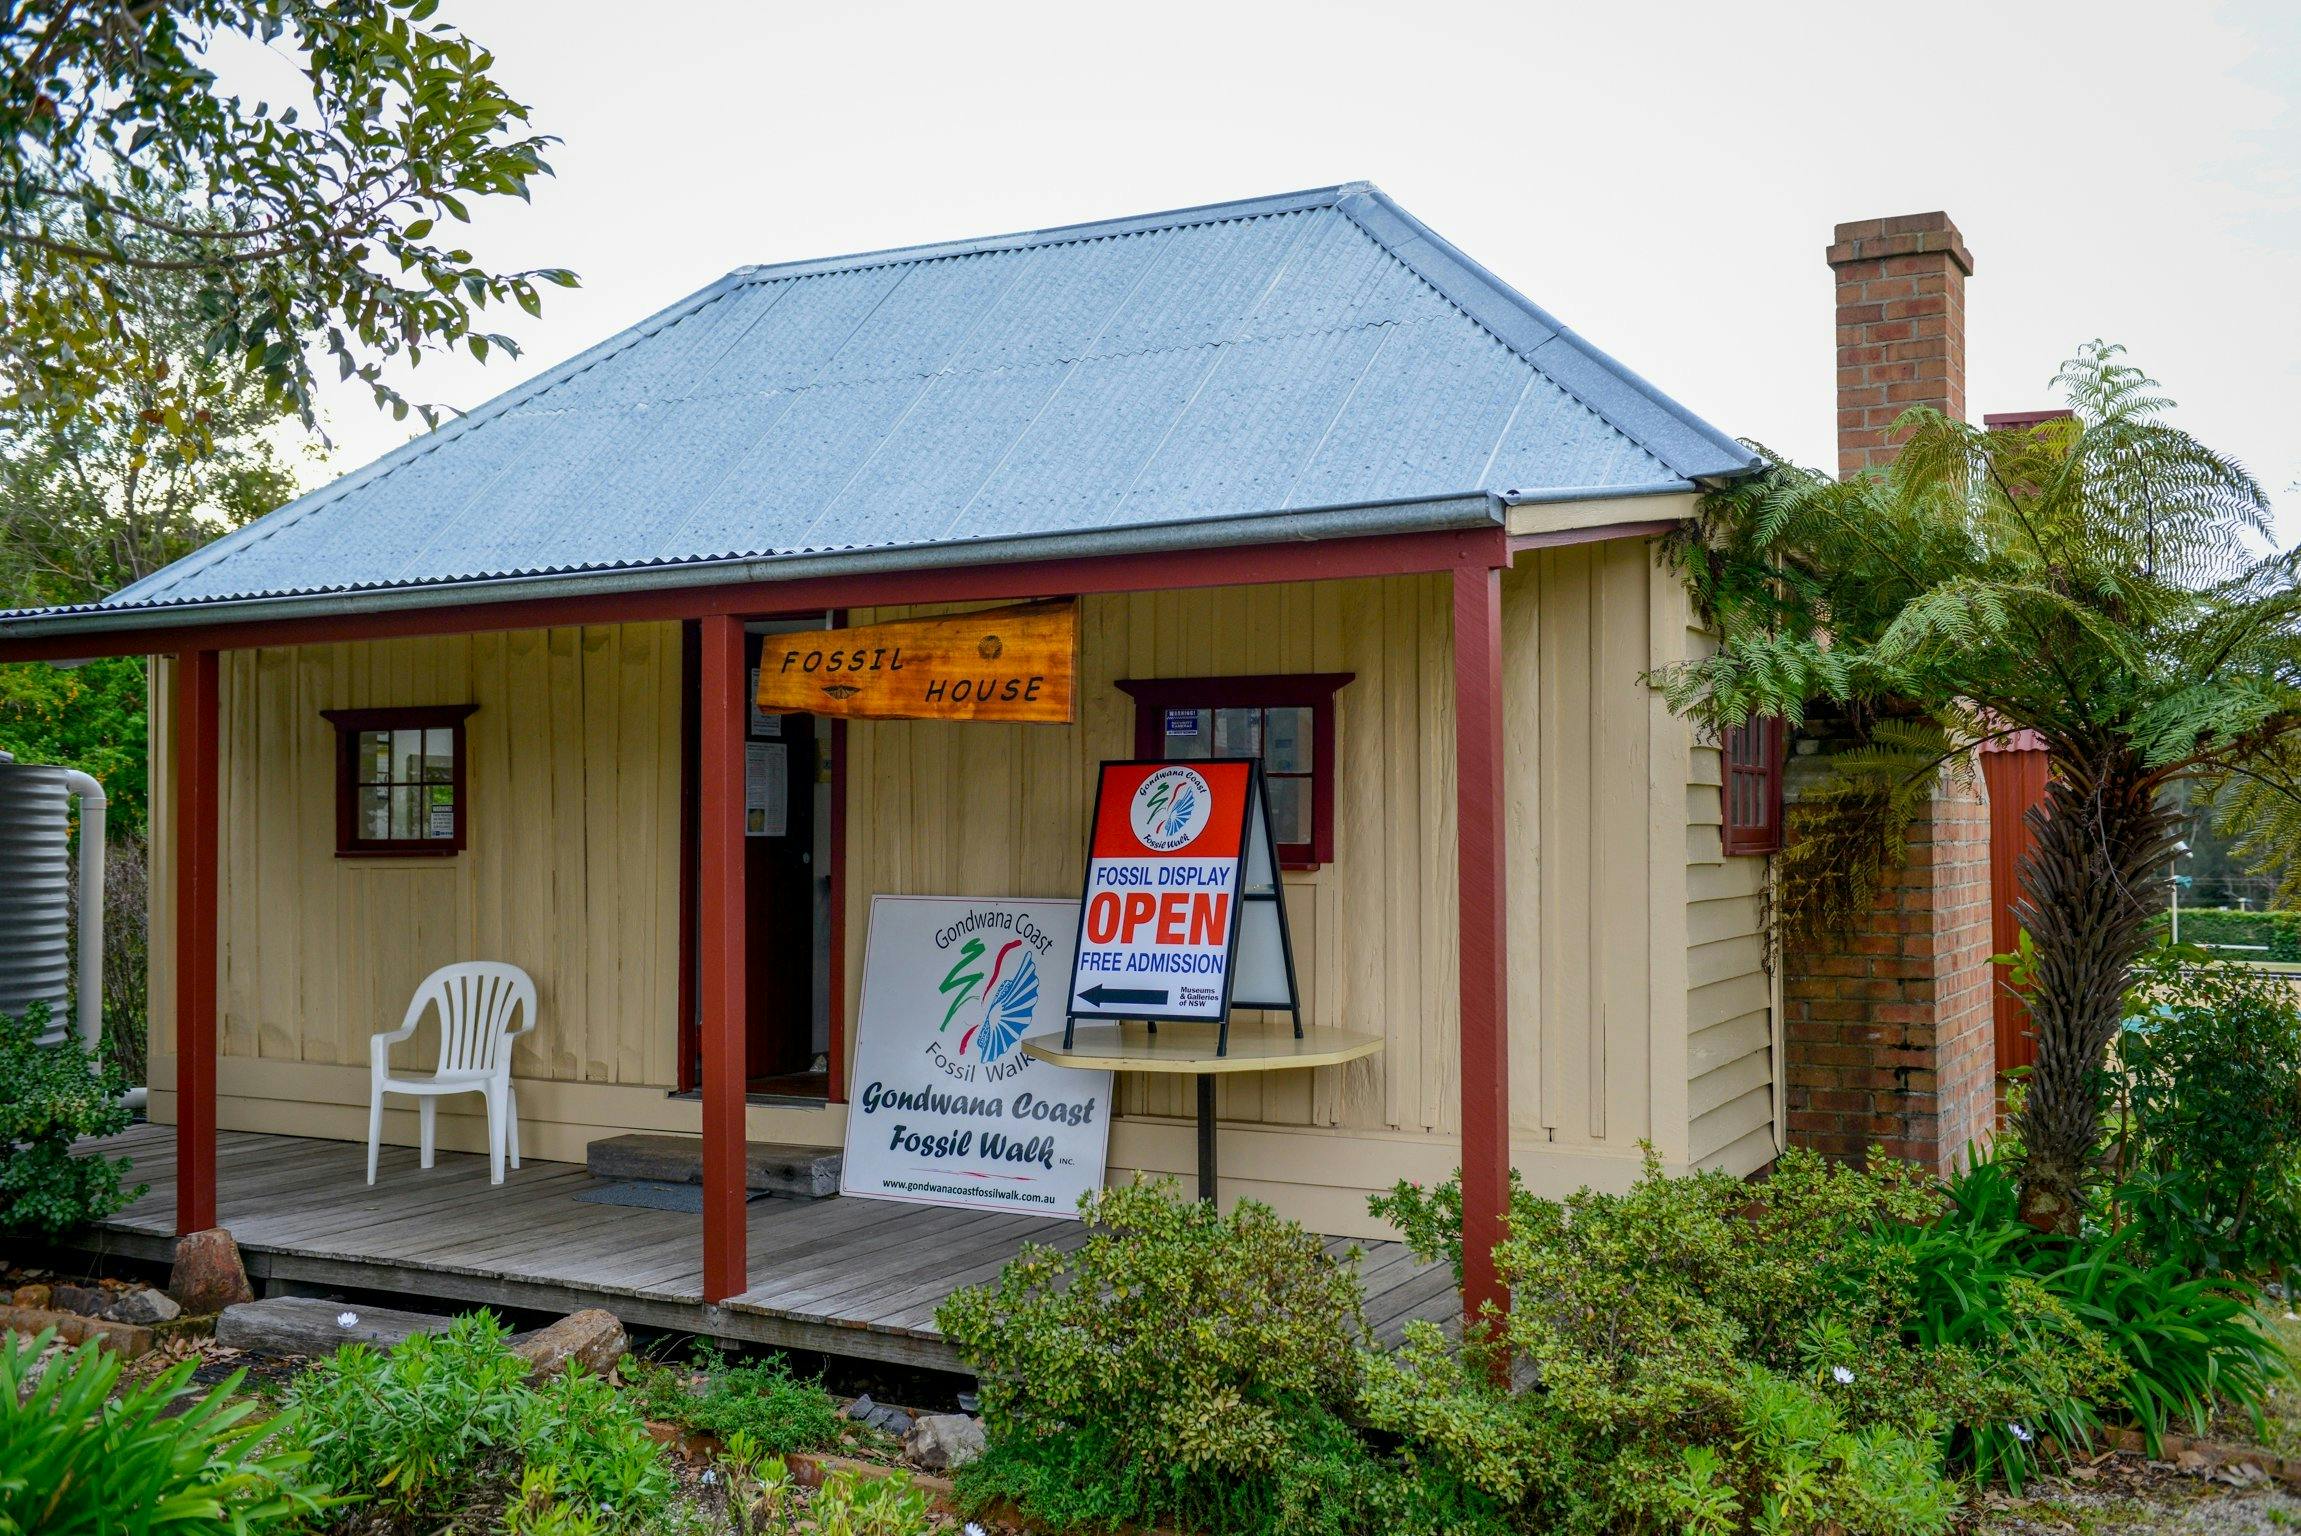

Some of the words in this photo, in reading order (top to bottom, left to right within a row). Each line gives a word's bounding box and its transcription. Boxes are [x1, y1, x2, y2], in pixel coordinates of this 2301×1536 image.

[781, 648, 904, 673] FOSSIL
[925, 676, 1044, 702] HOUSE
[1139, 770, 1184, 796] Gondwana
[1185, 771, 1207, 794] Coast
[1143, 833, 1166, 849] Fossil
[1167, 833, 1190, 848] Walk
[1096, 866, 1153, 886] FOSSIL
[1158, 866, 1230, 886] DISPLAY
[1087, 891, 1229, 946] OPEN
[935, 909, 1013, 949] Gondwana
[1015, 913, 1055, 956] Coast
[1080, 952, 1123, 971] FREE
[1125, 953, 1224, 974] ADMISSION
[1180, 986, 1215, 994] Museums
[1186, 993, 1219, 1001] Galleries
[925, 1041, 976, 1083] Fossil
[985, 1051, 1036, 1083] Walk
[862, 1081, 1003, 1118] Gondwana
[1011, 1092, 1095, 1126] Coast
[889, 1124, 973, 1158] Fossil
[979, 1131, 1055, 1170] Walk
[1058, 1156, 1076, 1166] INC.
[882, 1178, 1056, 1205] www.gondwanacoastfossilwalk.com.au
